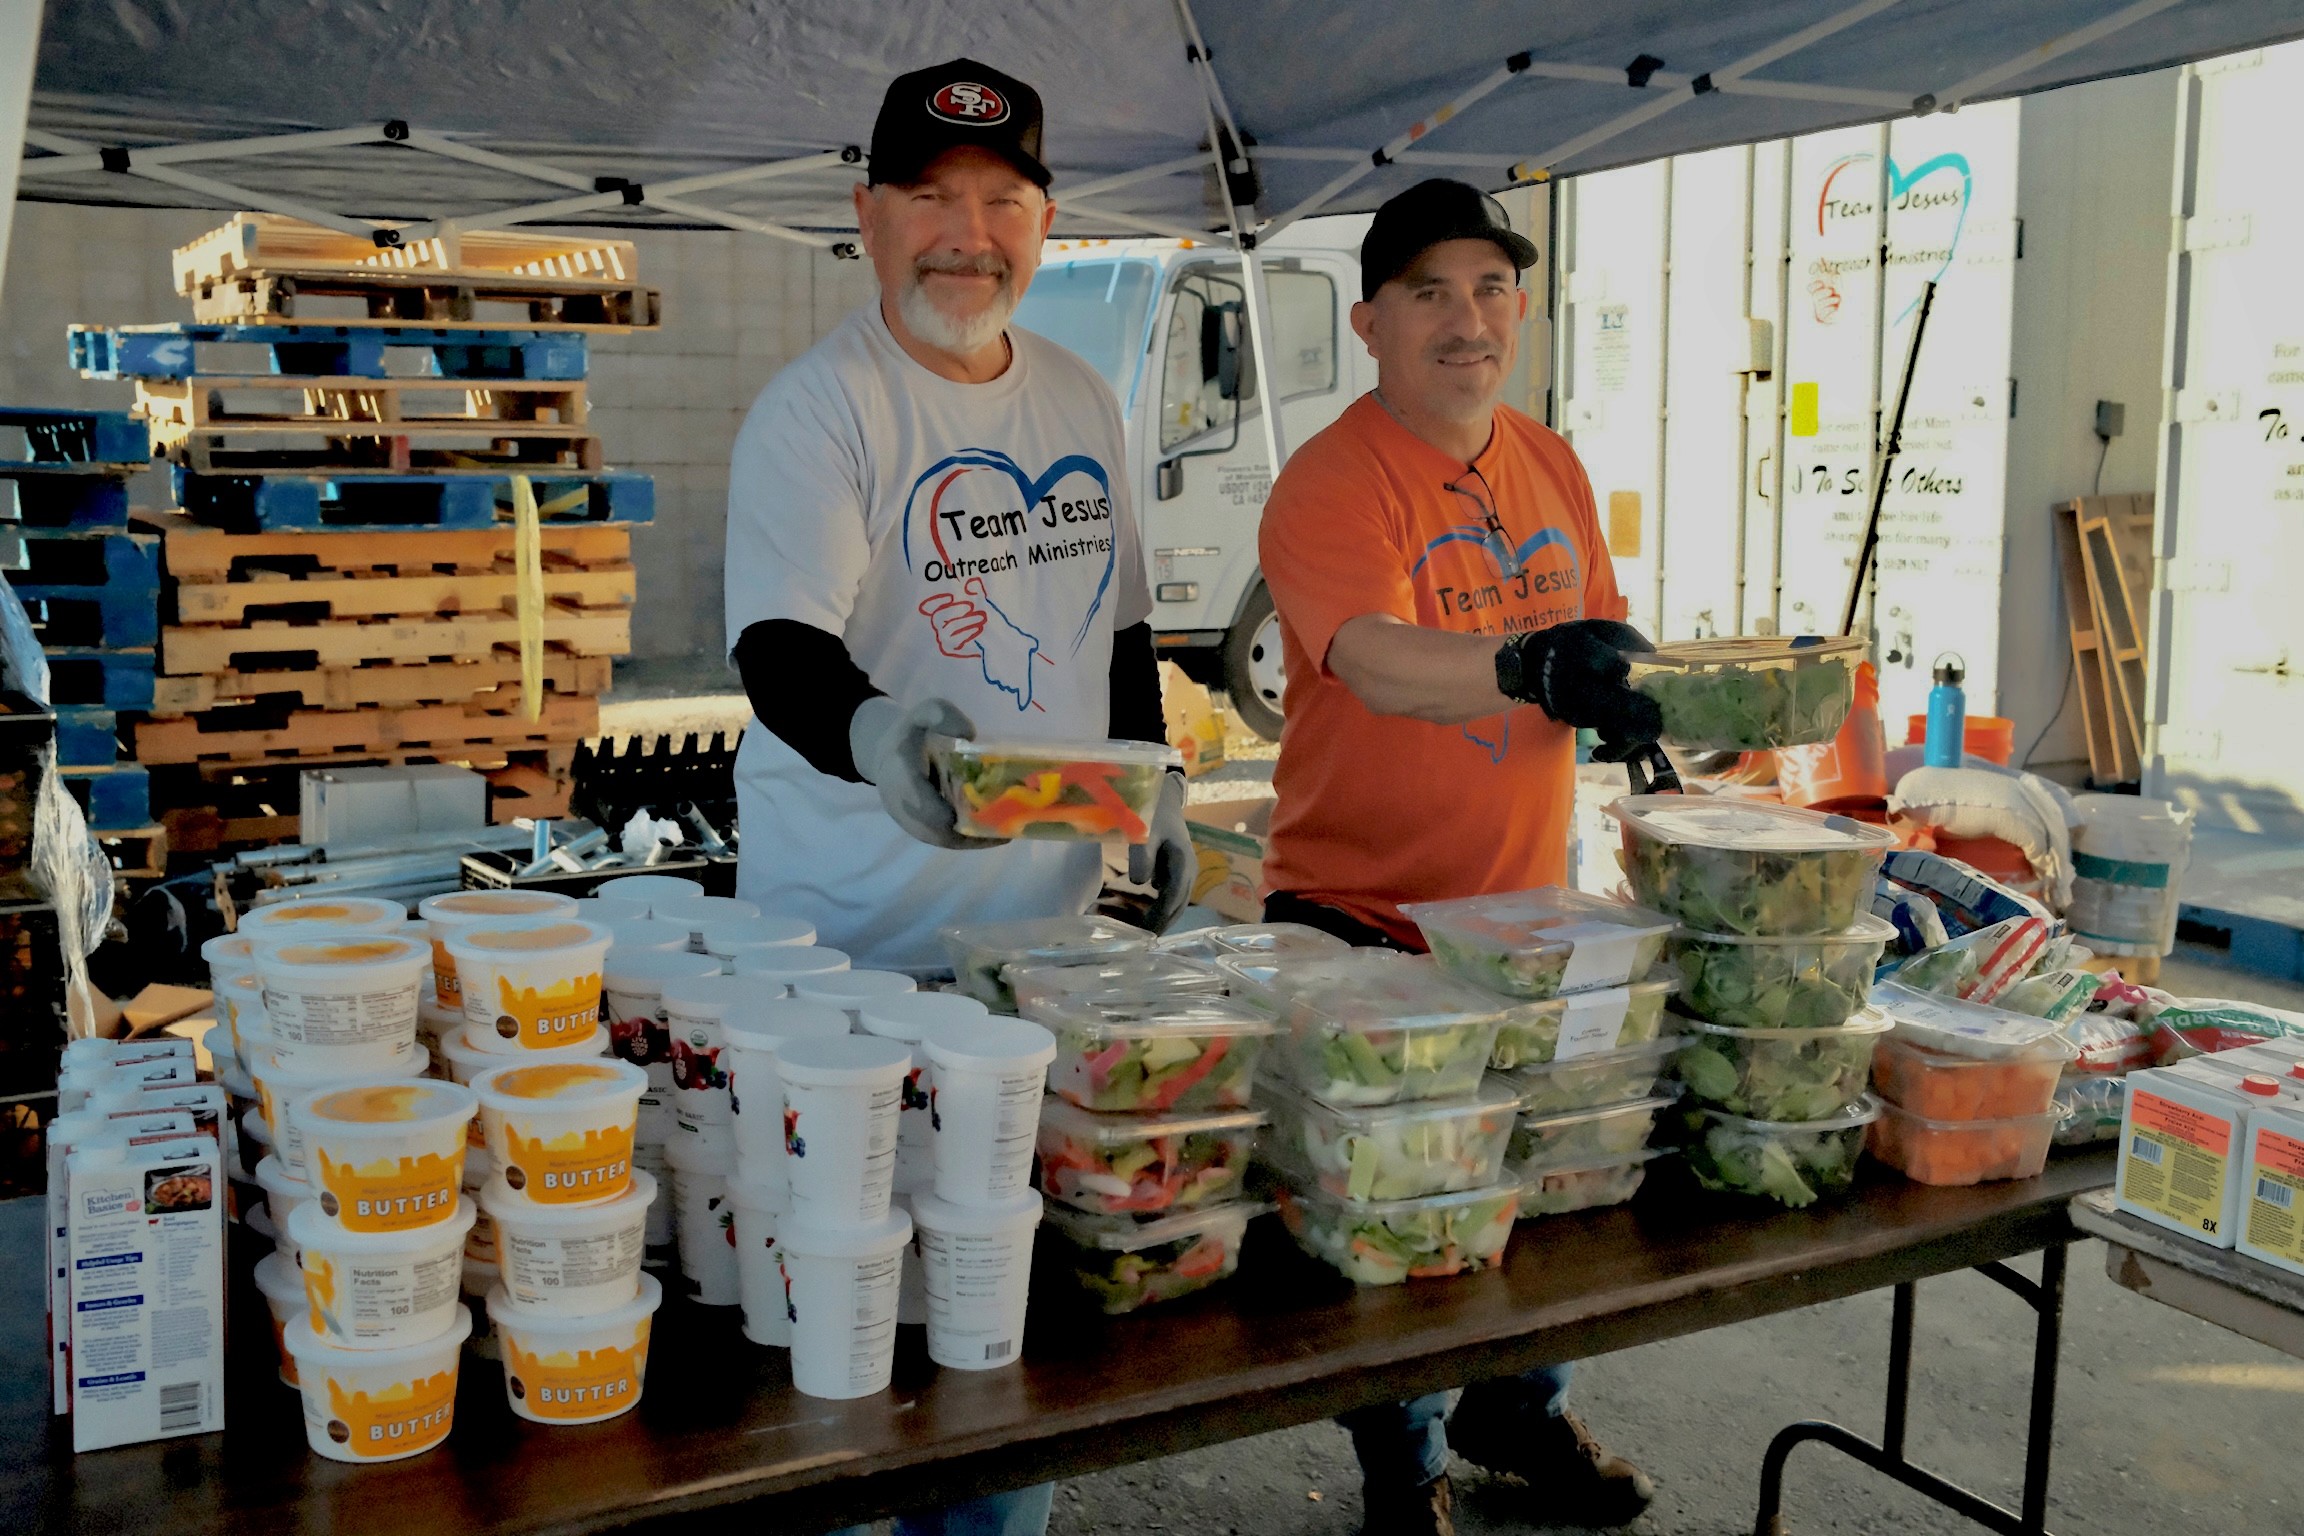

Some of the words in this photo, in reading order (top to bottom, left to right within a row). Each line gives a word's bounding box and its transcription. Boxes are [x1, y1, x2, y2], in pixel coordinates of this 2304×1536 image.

[950, 85, 996, 117] SF
[1897, 189, 1960, 211] Jesus
[1811, 465, 1833, 494] To
[1901, 466, 1963, 495] Others
[939, 509, 1027, 541] Team
[1040, 495, 1110, 528] Jesus
[924, 550, 1018, 582] Outreach
[1028, 535, 1112, 566] Ministries
[1435, 584, 1503, 616] Team
[1514, 567, 1578, 600] Jesus
[1503, 603, 1579, 633] Ministries
[544, 1159, 627, 1190] BUTTER
[87, 1191, 132, 1206] Kitchen
[87, 1202, 124, 1215] Basics
[356, 1188, 449, 1217] BUTTER
[2202, 1218, 2217, 1234] 8X
[510, 1236, 546, 1248] Nutrition
[353, 1269, 399, 1279] Nutrition
[353, 1278, 382, 1287] Facts
[541, 1276, 560, 1287] 100
[390, 1304, 410, 1316] 100
[539, 1378, 628, 1404] BUTTER
[369, 1402, 450, 1441] BUTTER
